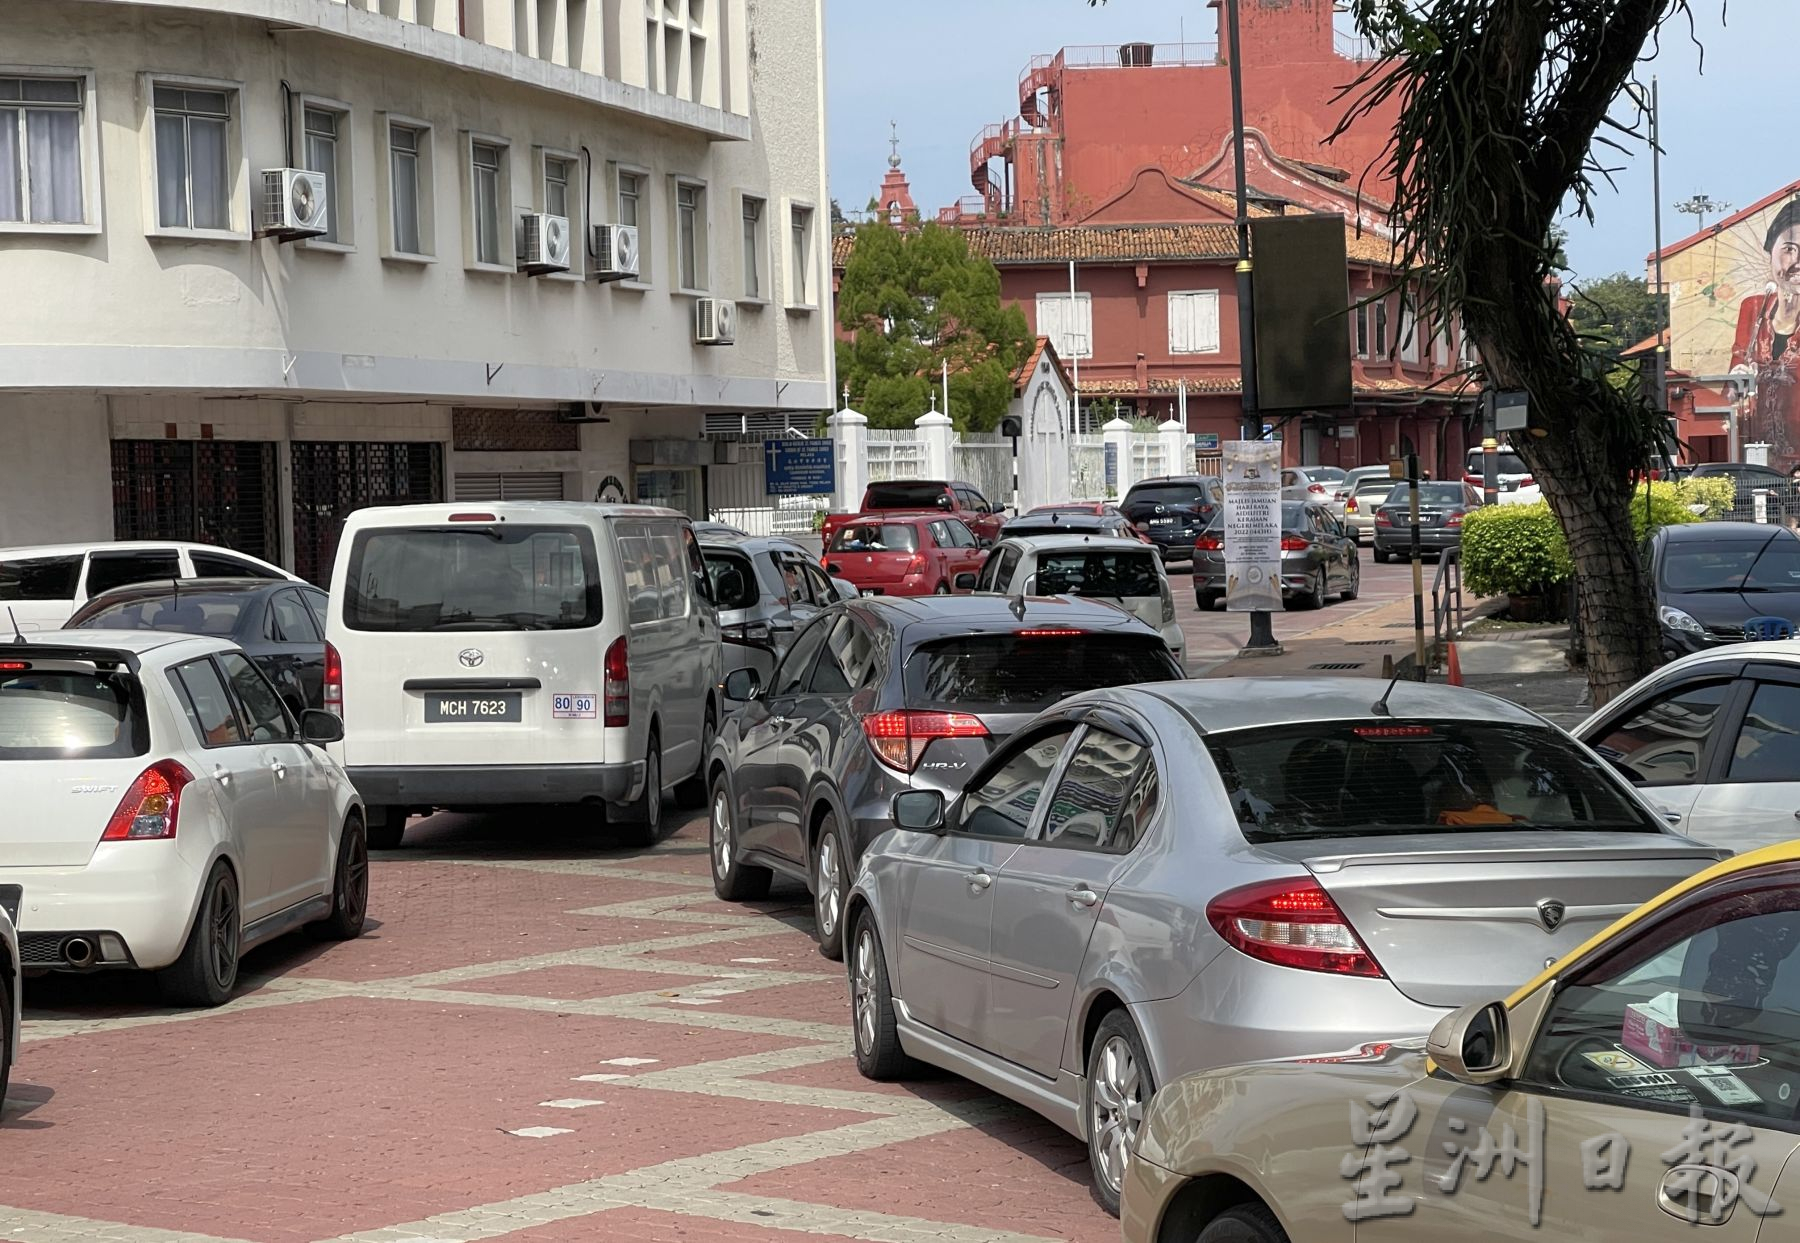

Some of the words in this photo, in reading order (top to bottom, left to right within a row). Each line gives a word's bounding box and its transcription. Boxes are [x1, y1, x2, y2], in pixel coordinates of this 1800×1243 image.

[440, 700, 467, 716] MCH
[472, 700, 506, 715] 7623
[555, 697, 570, 709] 80
[576, 699, 591, 711] 90
[922, 762, 967, 770] HR-V
[71, 785, 120, 793] SWIFT
